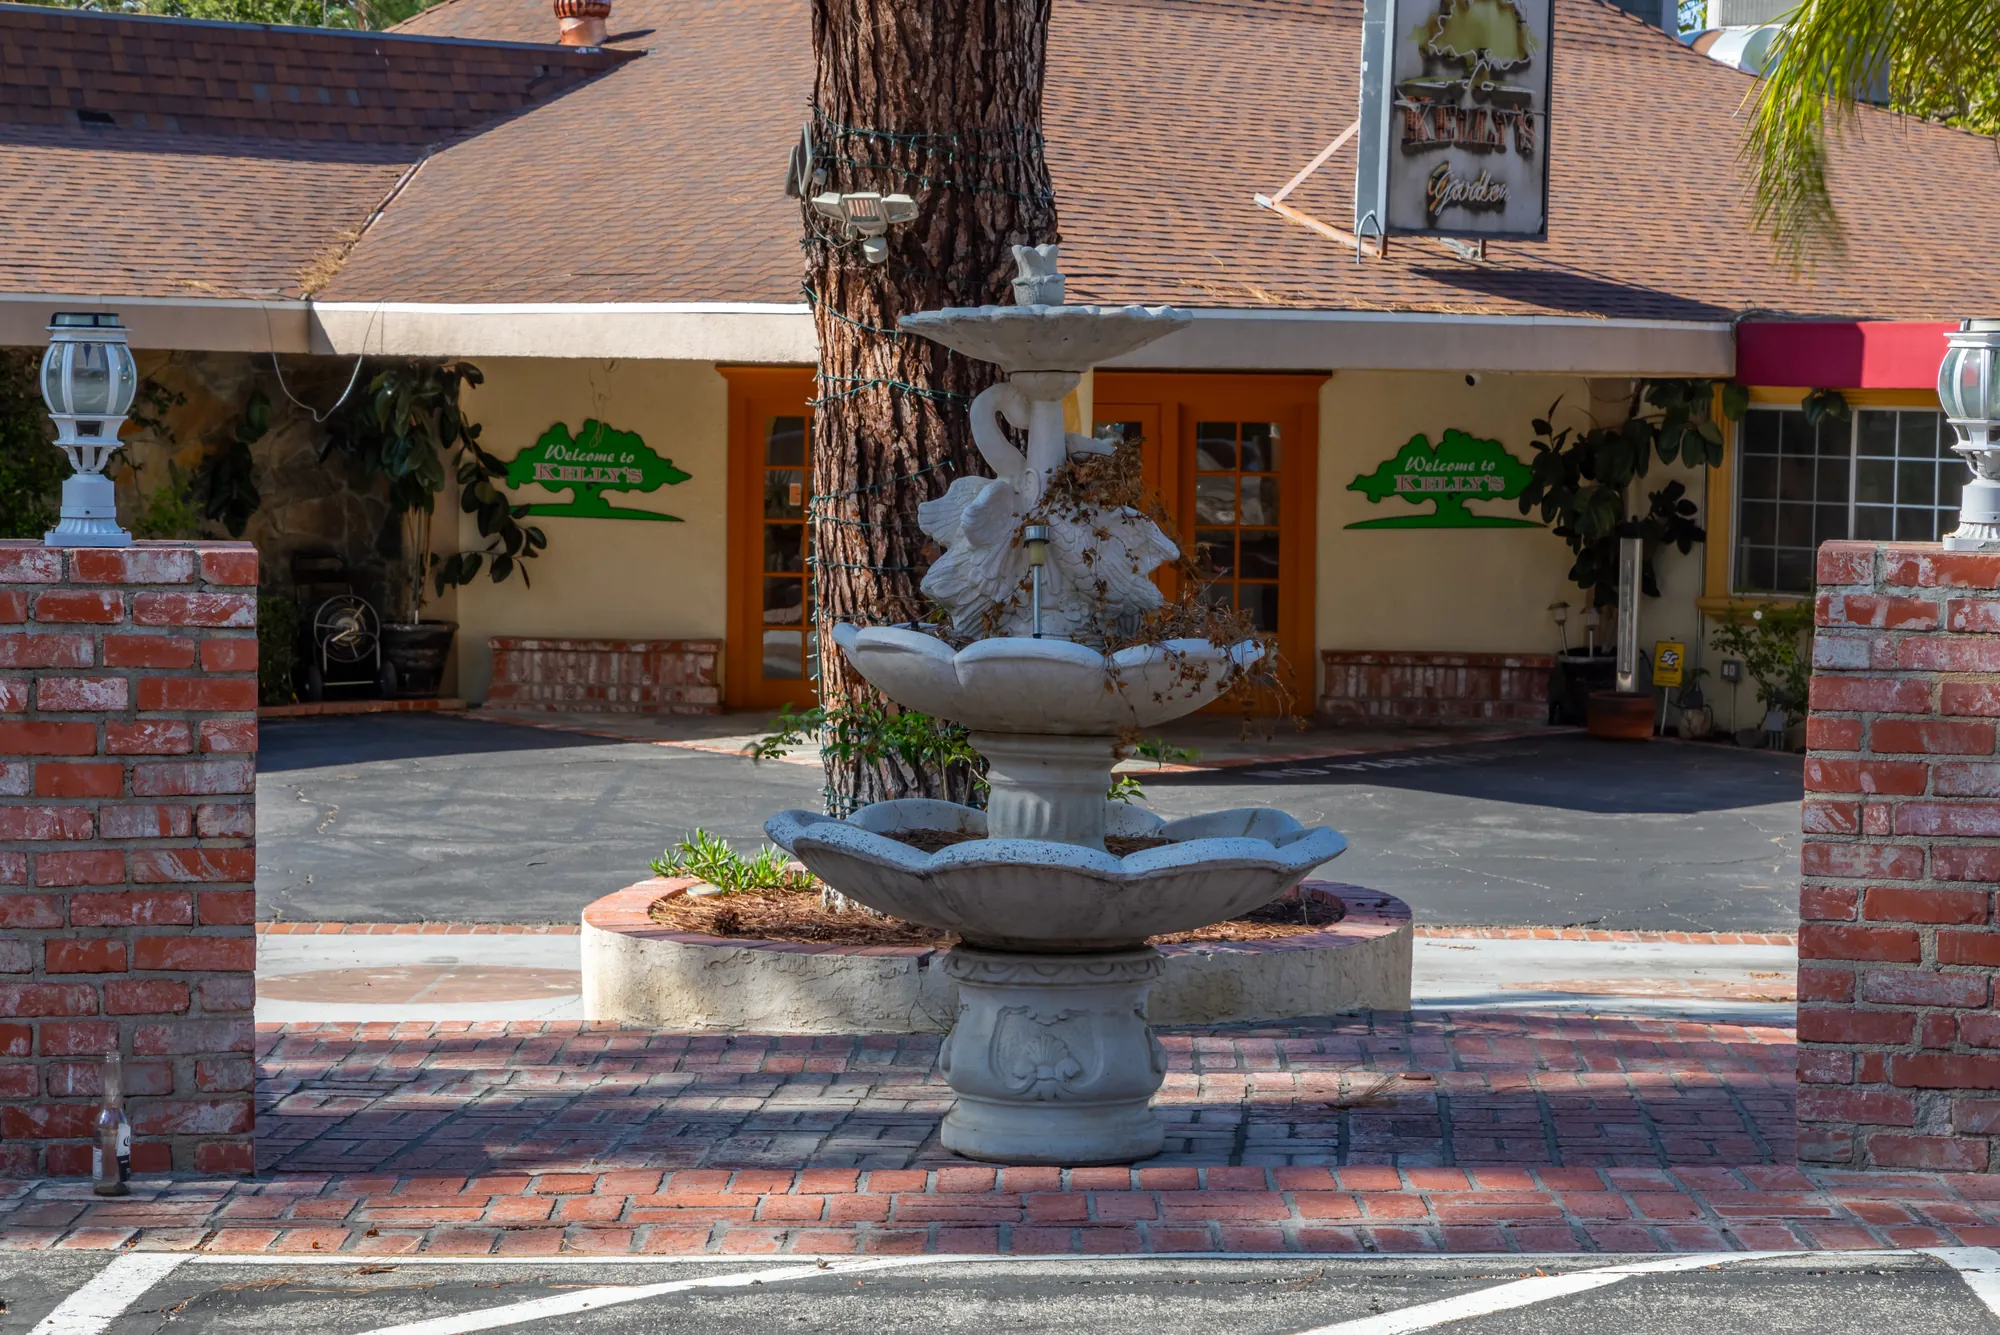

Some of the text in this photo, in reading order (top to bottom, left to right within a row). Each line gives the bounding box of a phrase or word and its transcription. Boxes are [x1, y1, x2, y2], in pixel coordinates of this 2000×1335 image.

[1428, 161, 1511, 215] Garden
[544, 444, 635, 463] Welcome to
[533, 462, 644, 484] KELLY'S
[1404, 456, 1496, 473] Welcome to
[1393, 474, 1506, 492] KELLY'S
